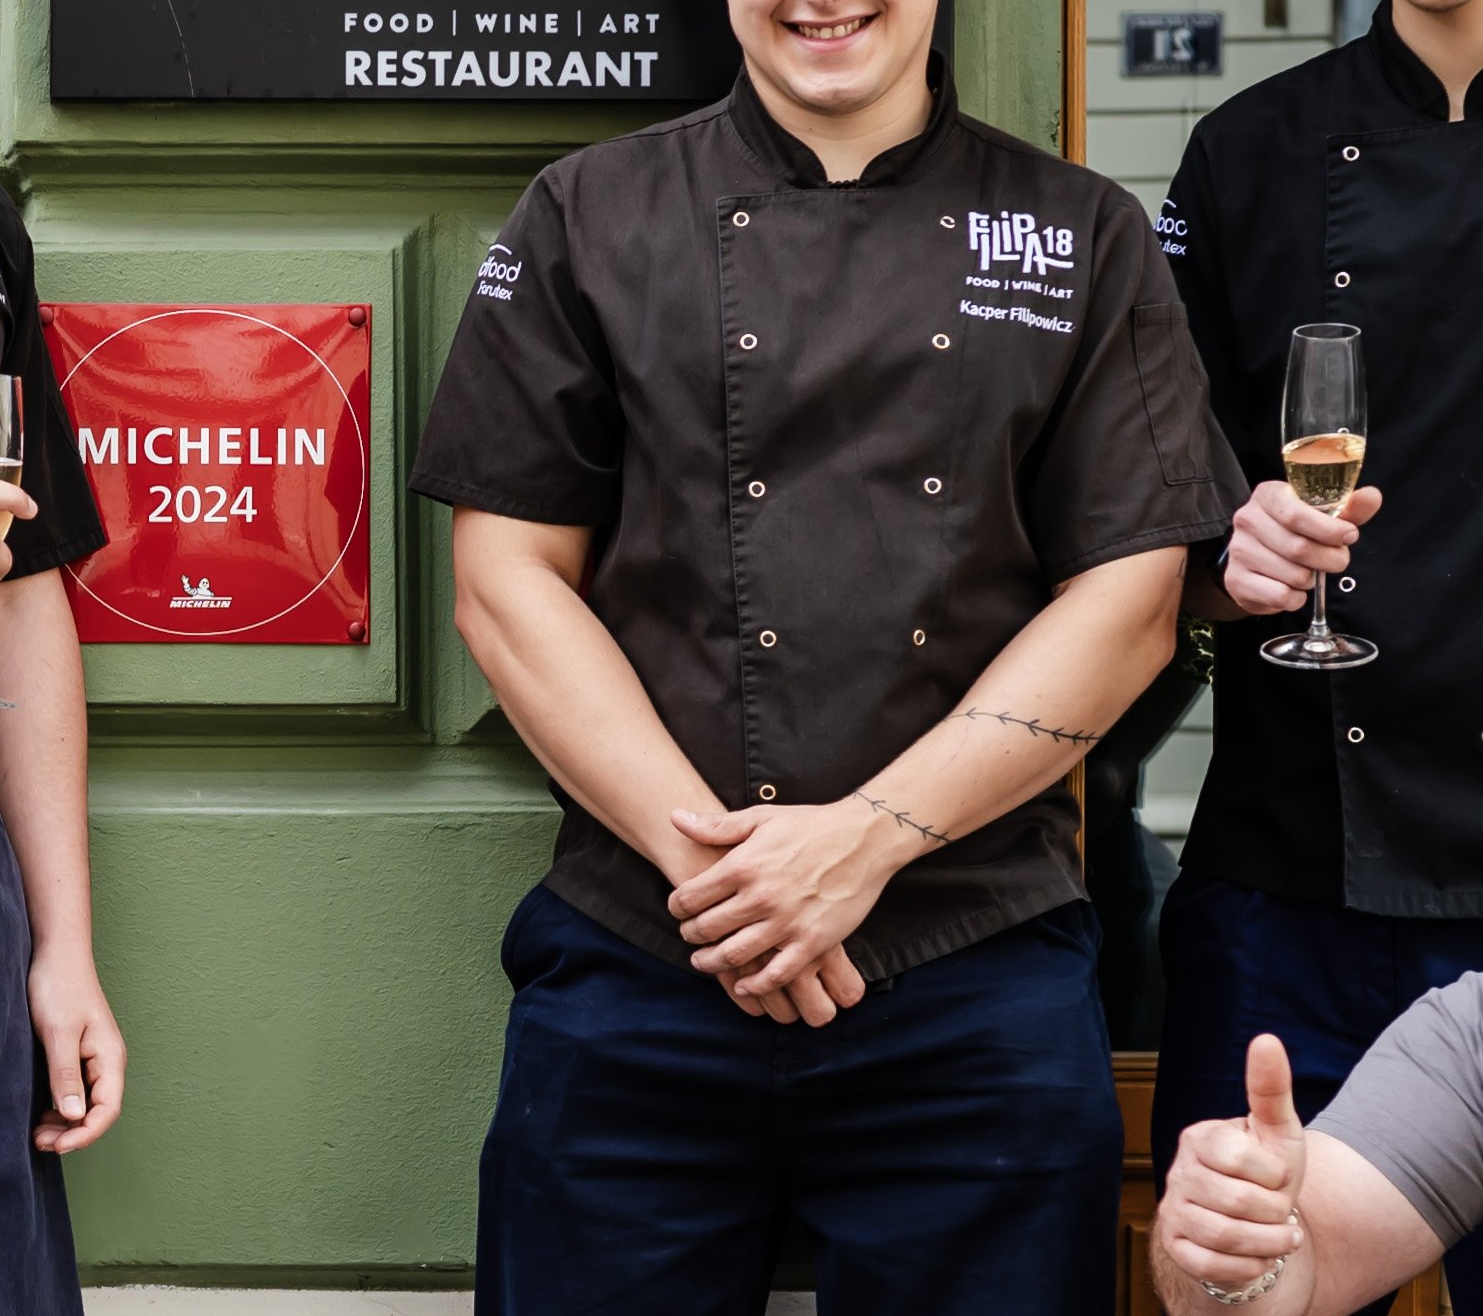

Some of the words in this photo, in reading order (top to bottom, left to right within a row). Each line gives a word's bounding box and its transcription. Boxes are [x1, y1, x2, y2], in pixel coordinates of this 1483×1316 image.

[344, 13, 434, 33] FOOD
[475, 13, 559, 33] WINE
[599, 13, 660, 33] ART
[345, 50, 659, 87] RESTAURANT
[1042, 225, 1073, 256] 18
[965, 276, 1001, 288] FOOD
[1011, 280, 1042, 293] WINE
[1048, 288, 1074, 299] ART
[959, 299, 1009, 321] Kacper
[1009, 306, 1073, 333] Filipowicz
[78, 428, 325, 465] MICHELIN
[148, 485, 257, 523] 2024
[170, 600, 231, 608] MICHELIN
